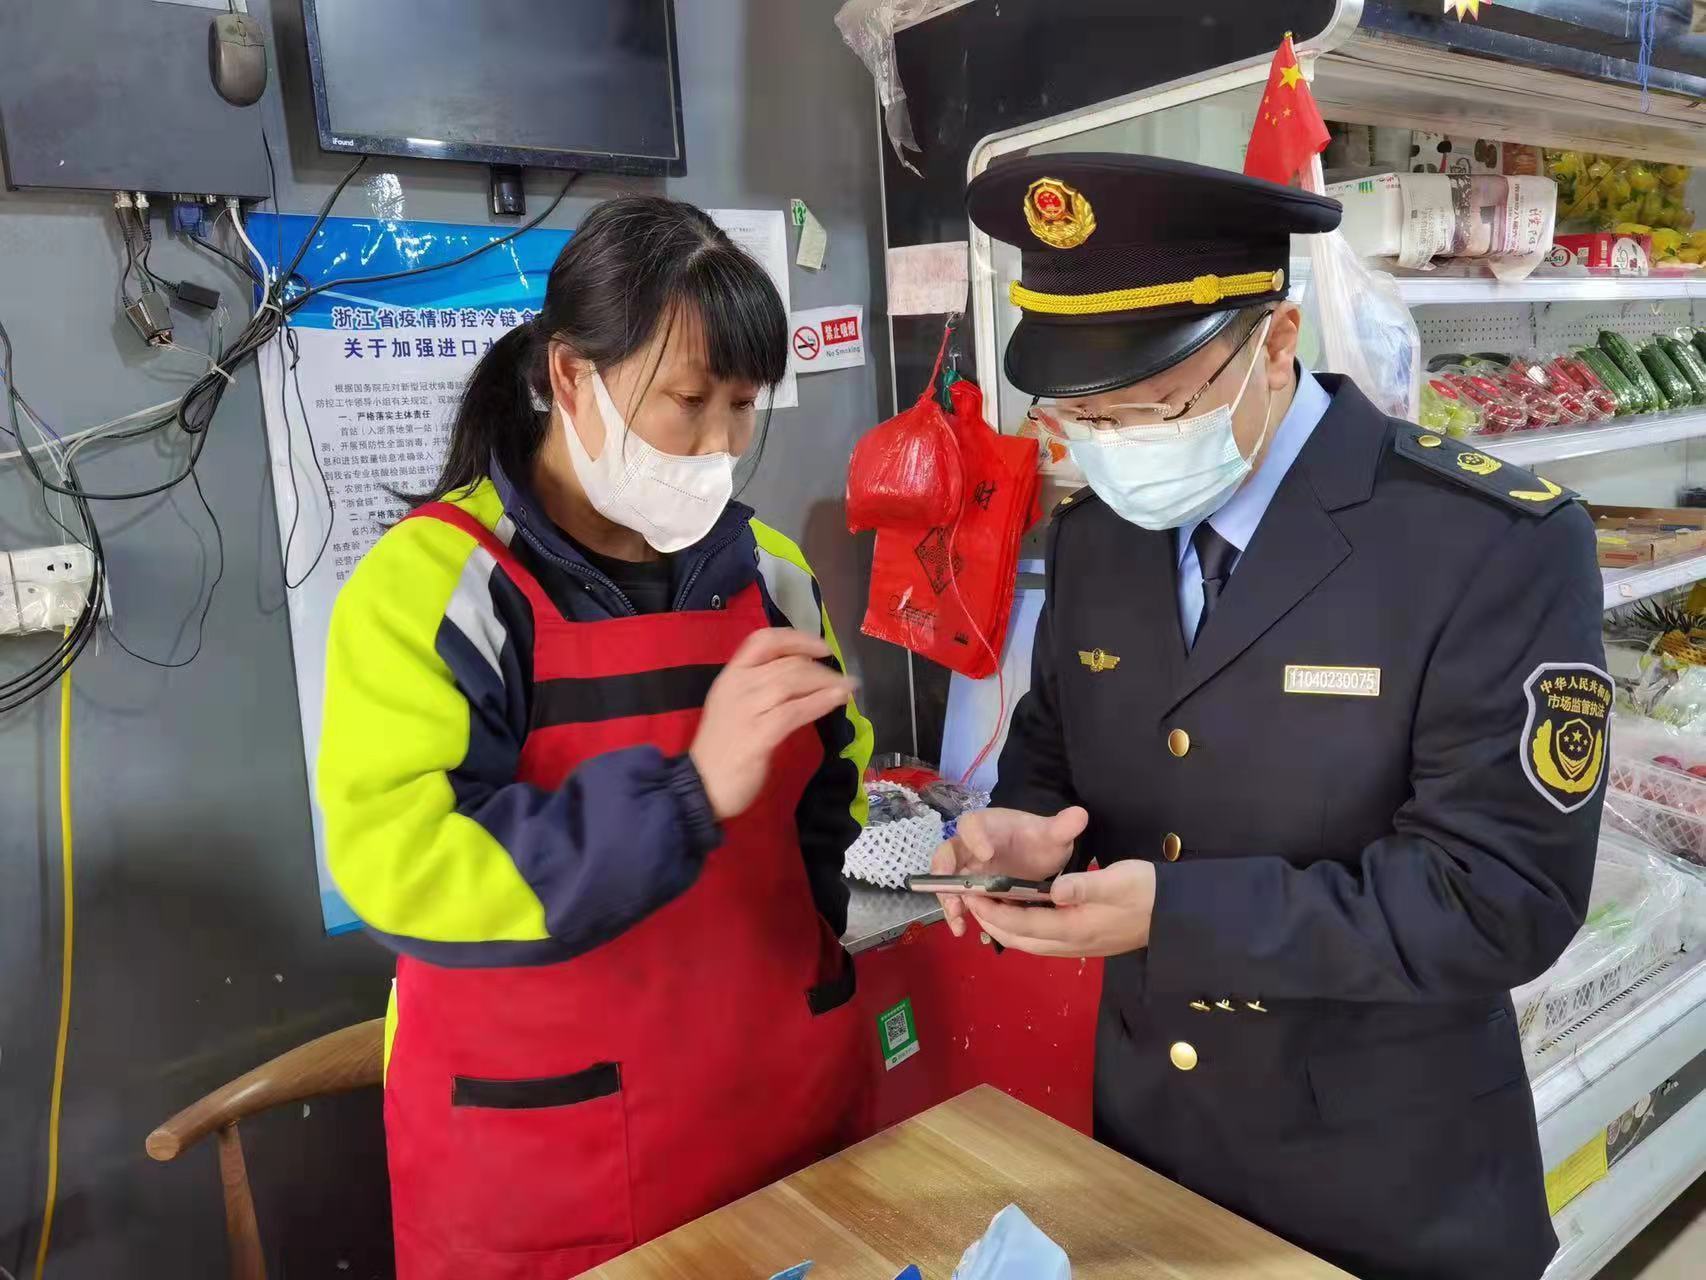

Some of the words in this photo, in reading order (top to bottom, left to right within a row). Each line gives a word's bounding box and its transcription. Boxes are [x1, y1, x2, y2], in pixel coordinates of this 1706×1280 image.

[332, 137, 354, 147] iFound
[825, 320, 856, 341] 禁止吸烟
